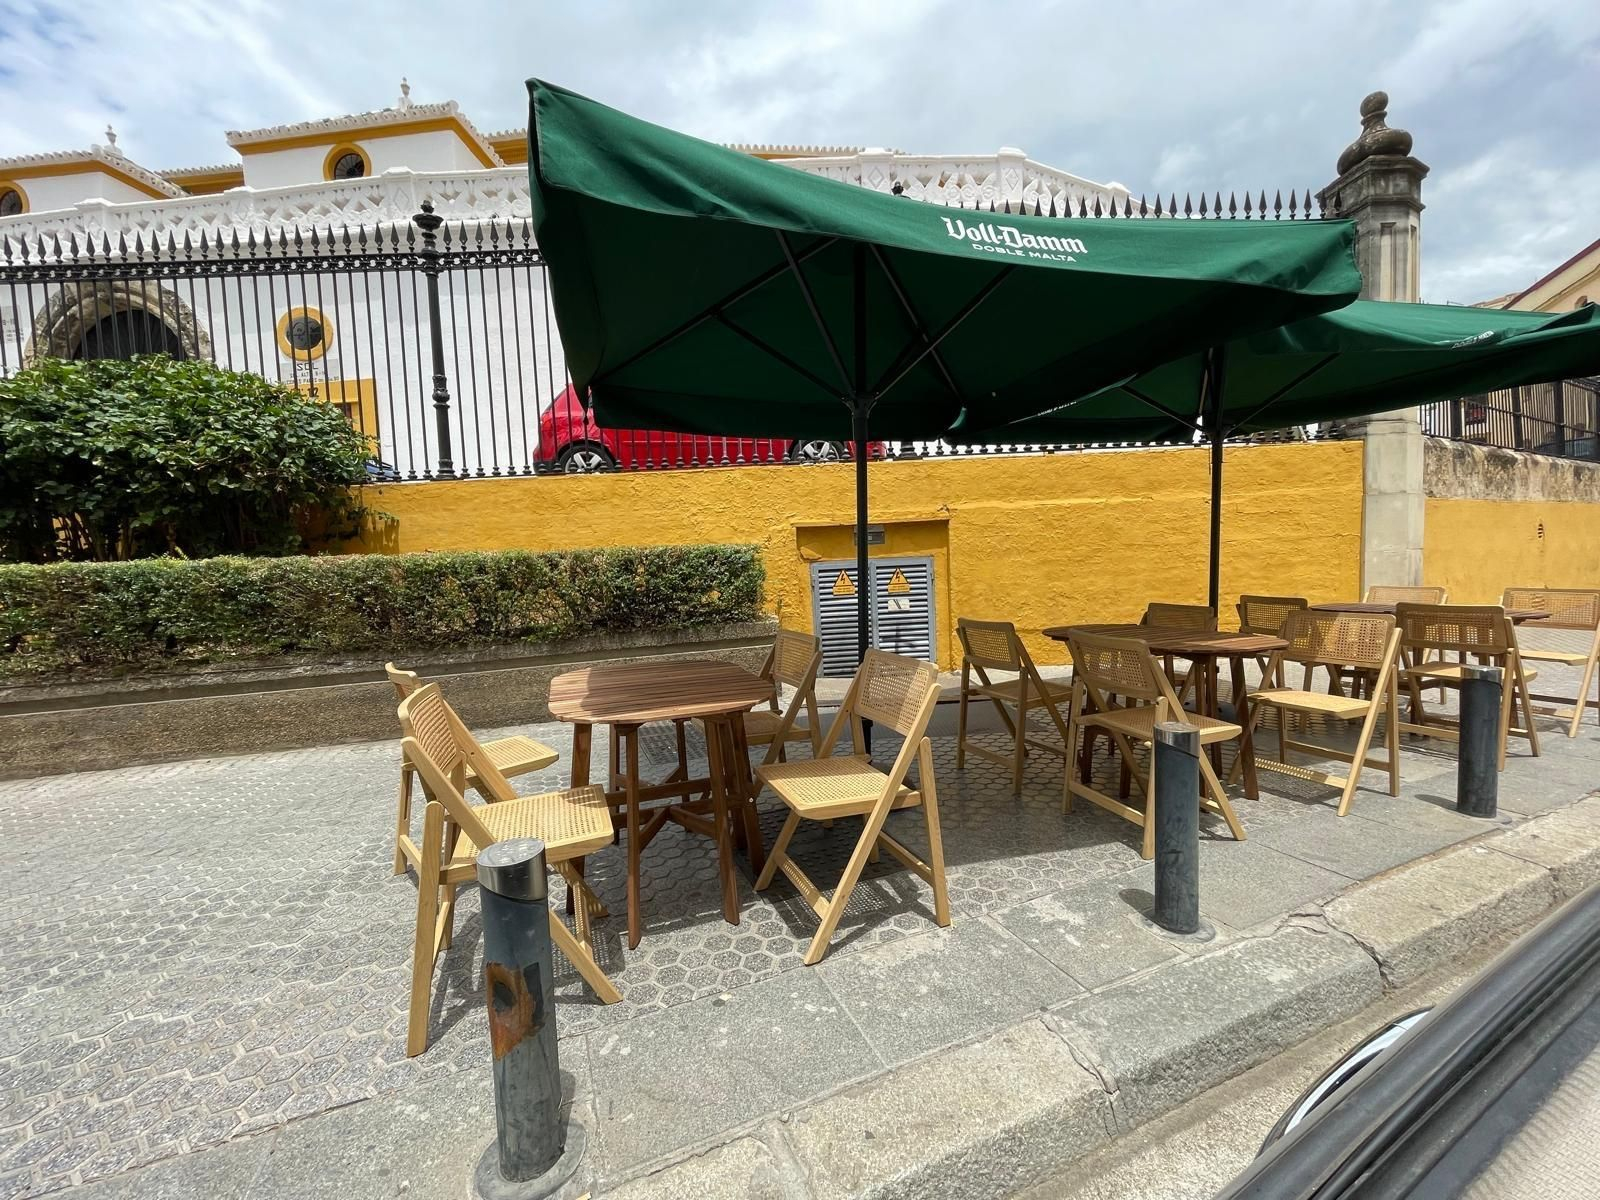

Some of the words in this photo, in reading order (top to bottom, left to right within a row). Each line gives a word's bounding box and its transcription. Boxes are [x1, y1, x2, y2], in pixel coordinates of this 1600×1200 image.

[940, 216, 1088, 254] Voll-Damm
[972, 243, 1026, 257] DOBLE
[1028, 251, 1077, 262] MALTA
[297, 363, 319, 371] SOL
